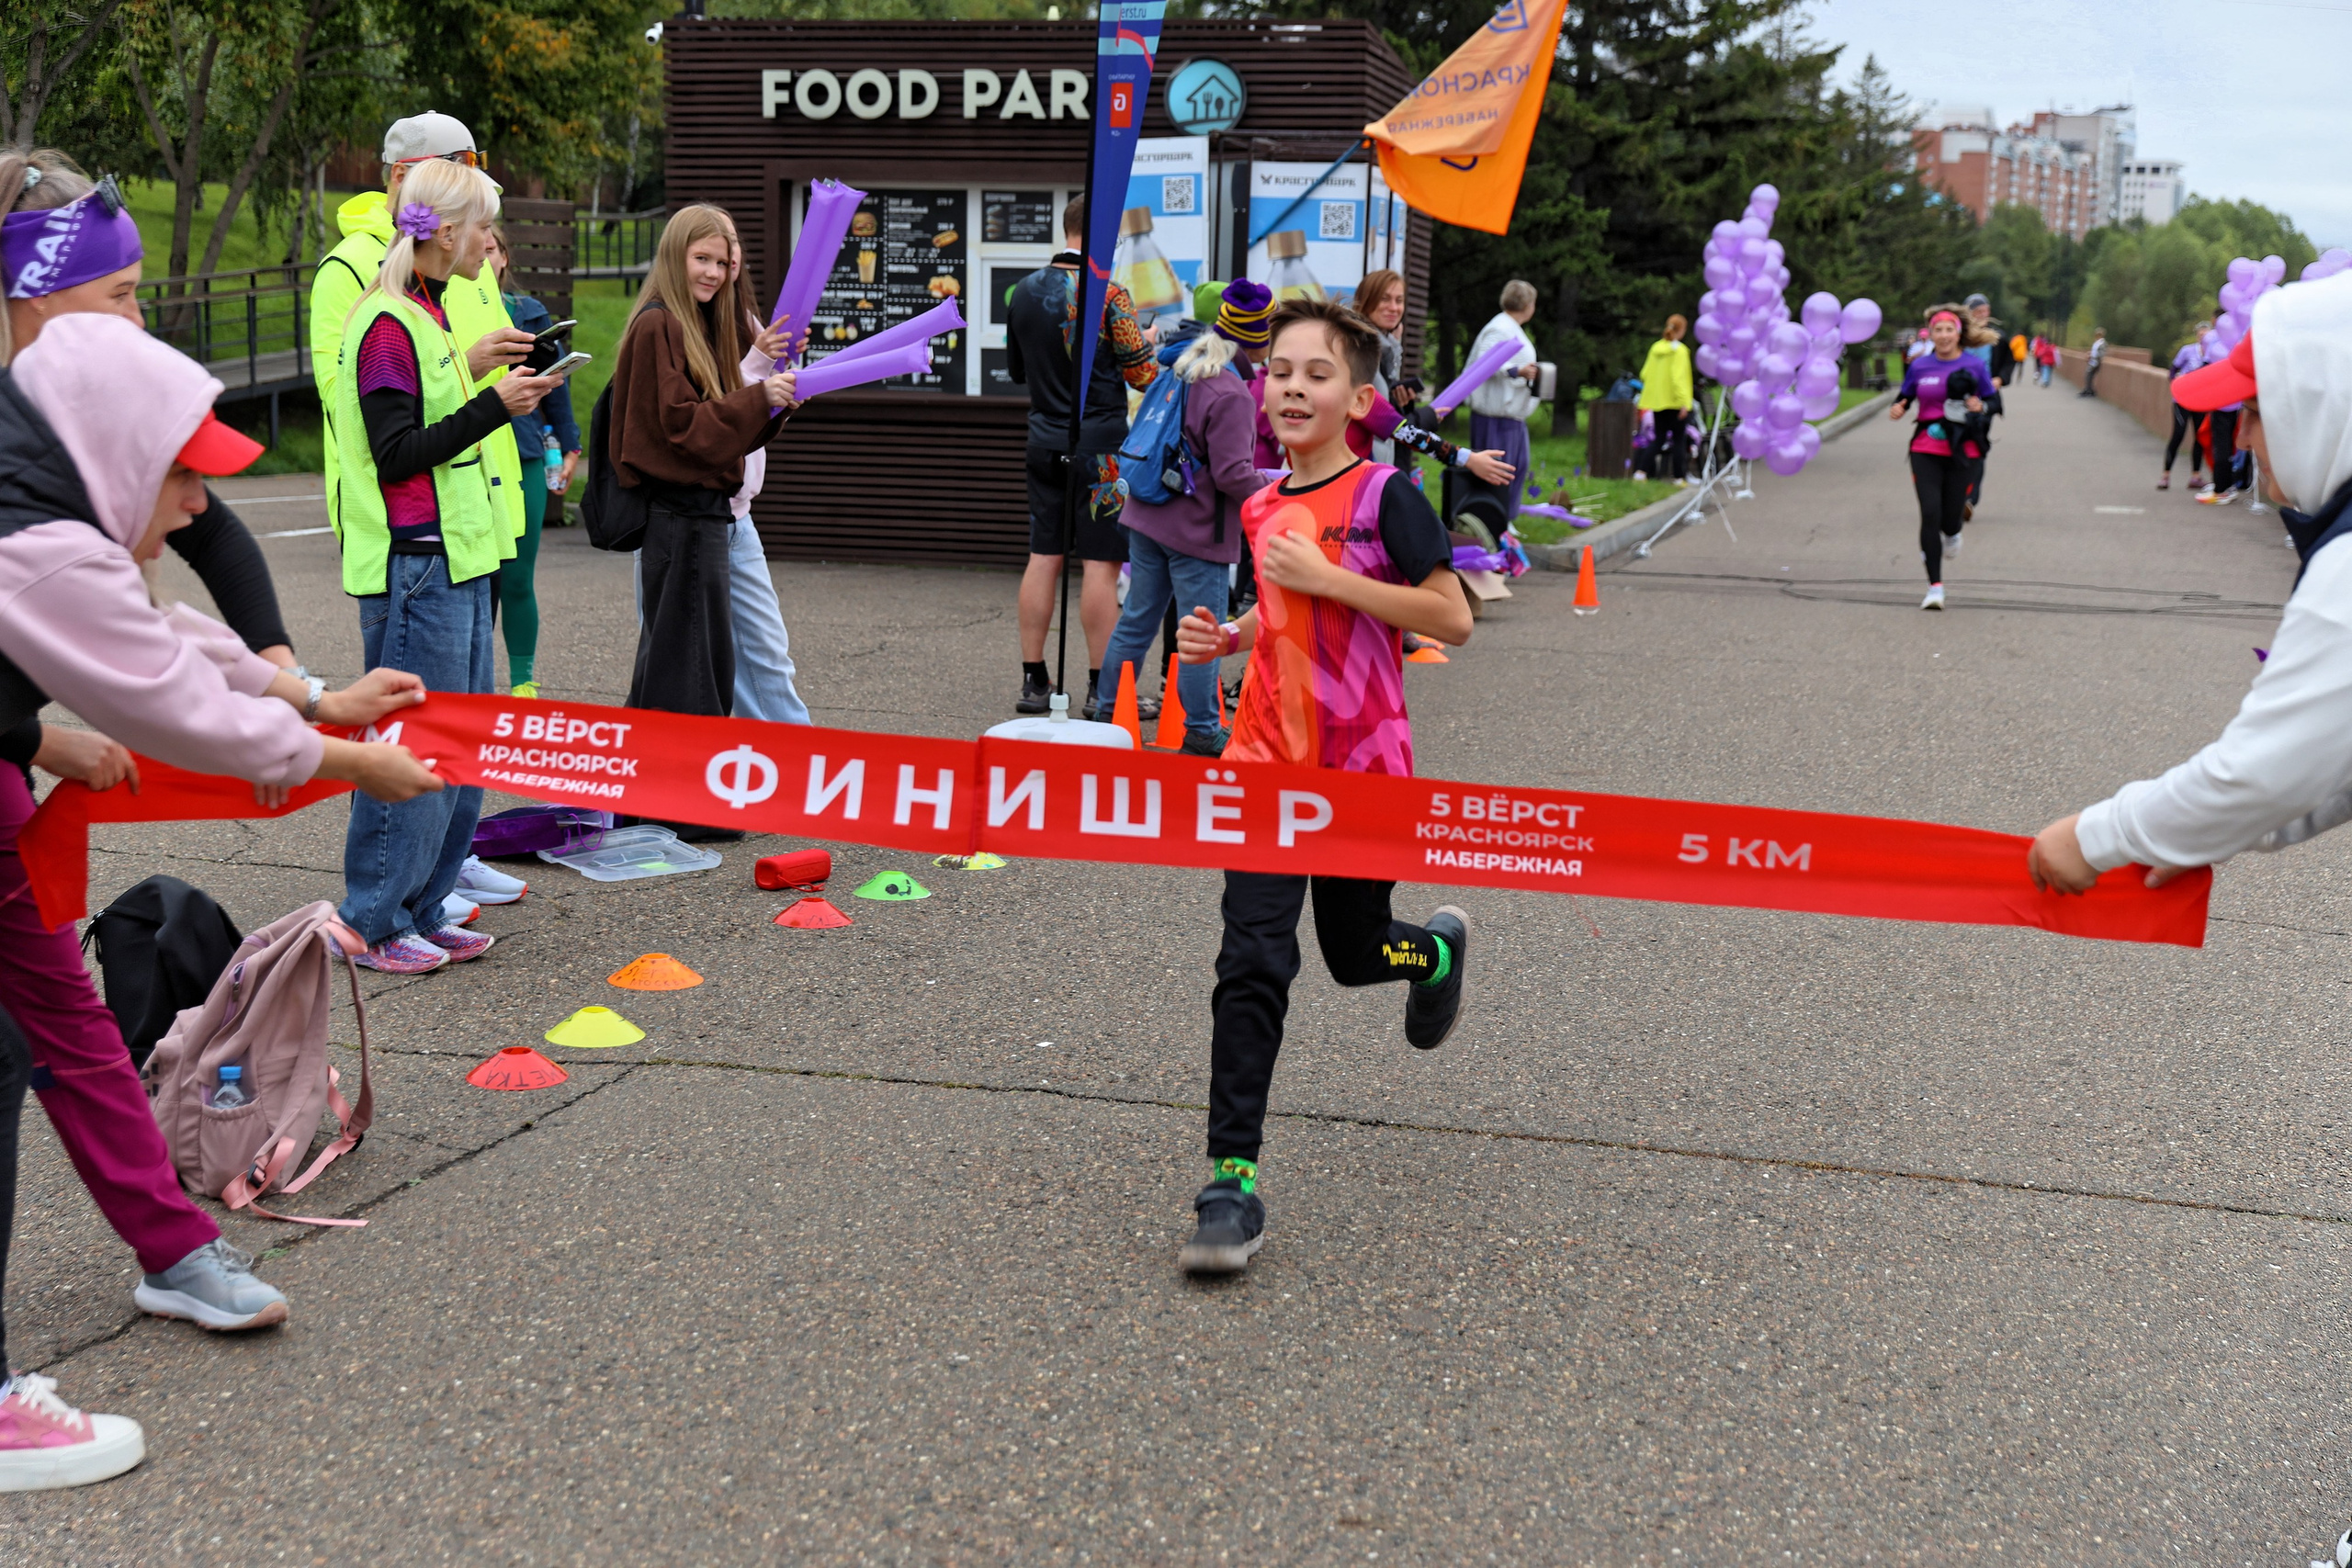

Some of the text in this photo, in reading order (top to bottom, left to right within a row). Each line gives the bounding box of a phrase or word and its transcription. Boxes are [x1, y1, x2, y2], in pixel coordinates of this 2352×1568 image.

[762, 68, 1091, 120] FOOD PAR
[8, 202, 80, 299] TRAIL
[492, 711, 632, 749] 5 ВЁРСТ
[478, 744, 639, 778] КРАСНОЯРСК
[481, 769, 626, 799] НАБЕРЕЖНАЯ
[705, 743, 1334, 848] ФИНИШЁР
[1430, 793, 1585, 829] 5 ВЁРСТ
[1416, 822, 1595, 853] КРАСНОЯРСК
[1677, 833, 1813, 872] 5 КМ
[1425, 849, 1583, 877] НАБЕРЕЖНАЯ
